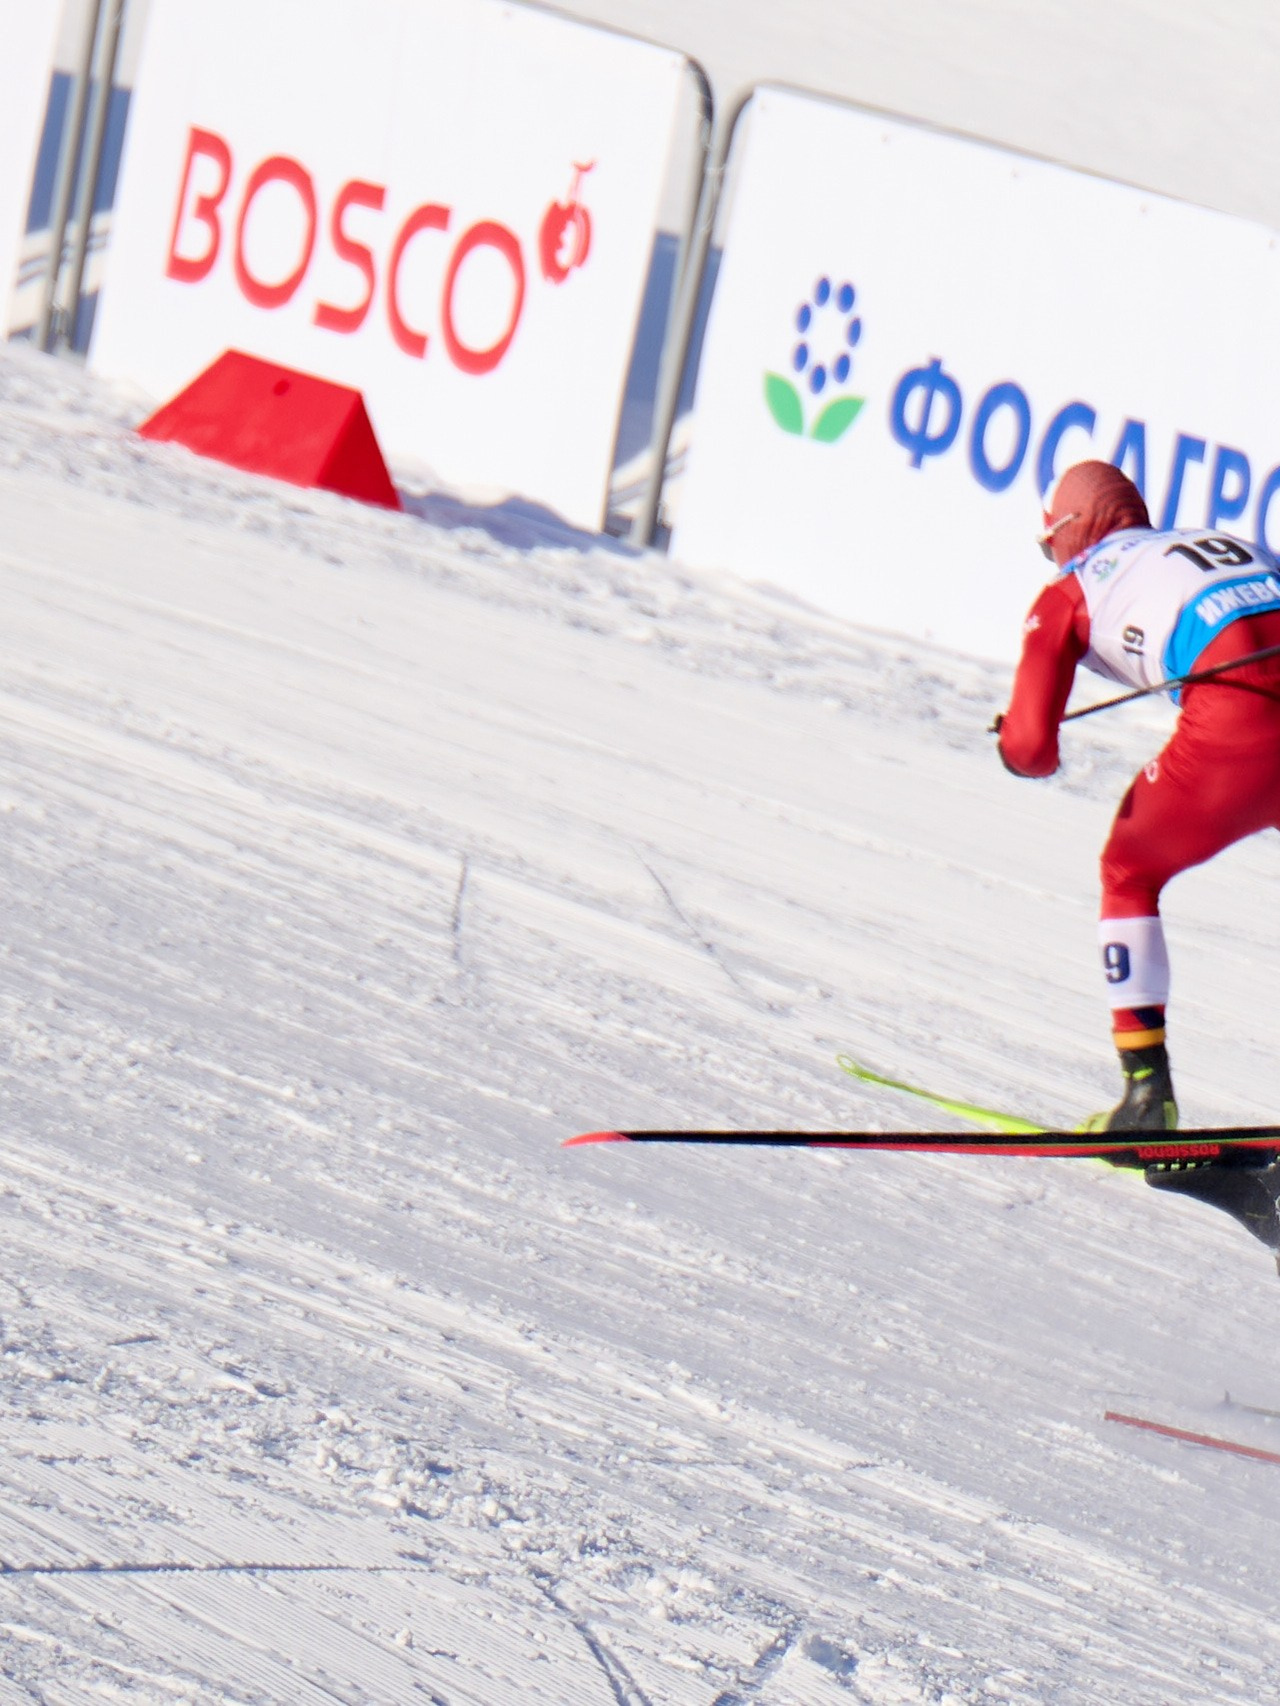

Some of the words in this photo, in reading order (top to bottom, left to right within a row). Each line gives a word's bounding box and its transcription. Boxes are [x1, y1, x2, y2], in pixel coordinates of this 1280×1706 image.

[165, 124, 527, 375] BOSCO
[1164, 537, 1254, 572] 19
[1122, 624, 1145, 656] 19
